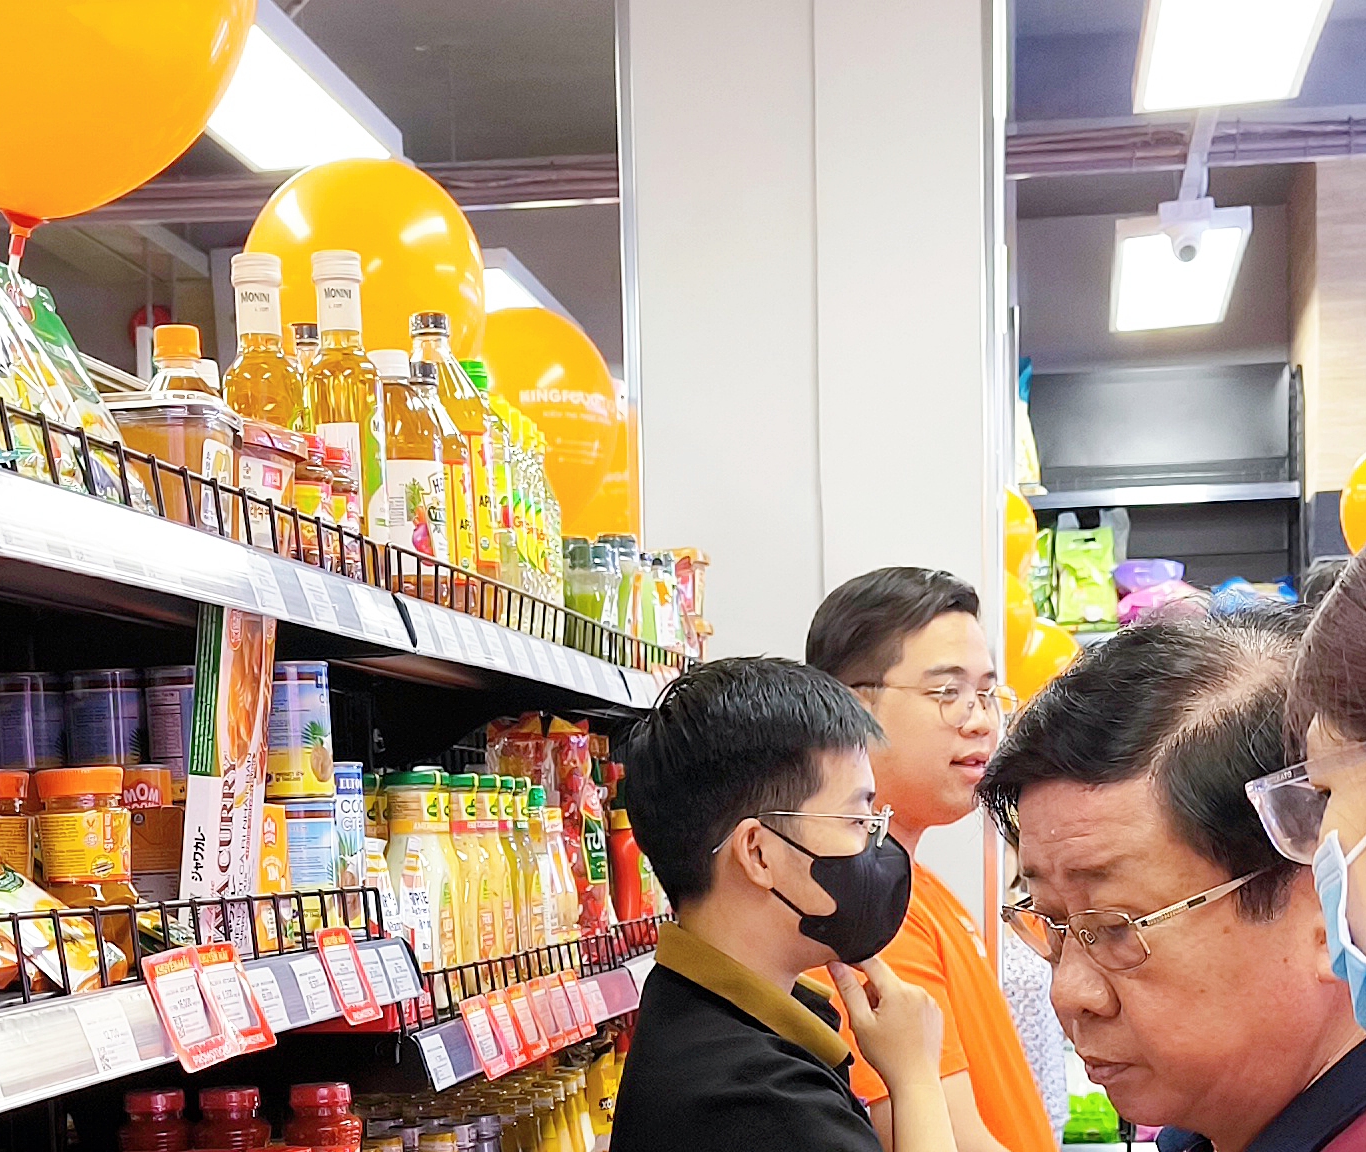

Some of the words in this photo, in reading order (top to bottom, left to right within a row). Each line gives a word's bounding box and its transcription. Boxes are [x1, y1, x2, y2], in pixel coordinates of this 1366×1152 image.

[240, 290, 271, 304] MONINI
[323, 286, 353, 300] MONINI
[123, 782, 161, 805] MOM
[217, 756, 237, 874] CURRY
[191, 825, 207, 883] ジャワカレー
